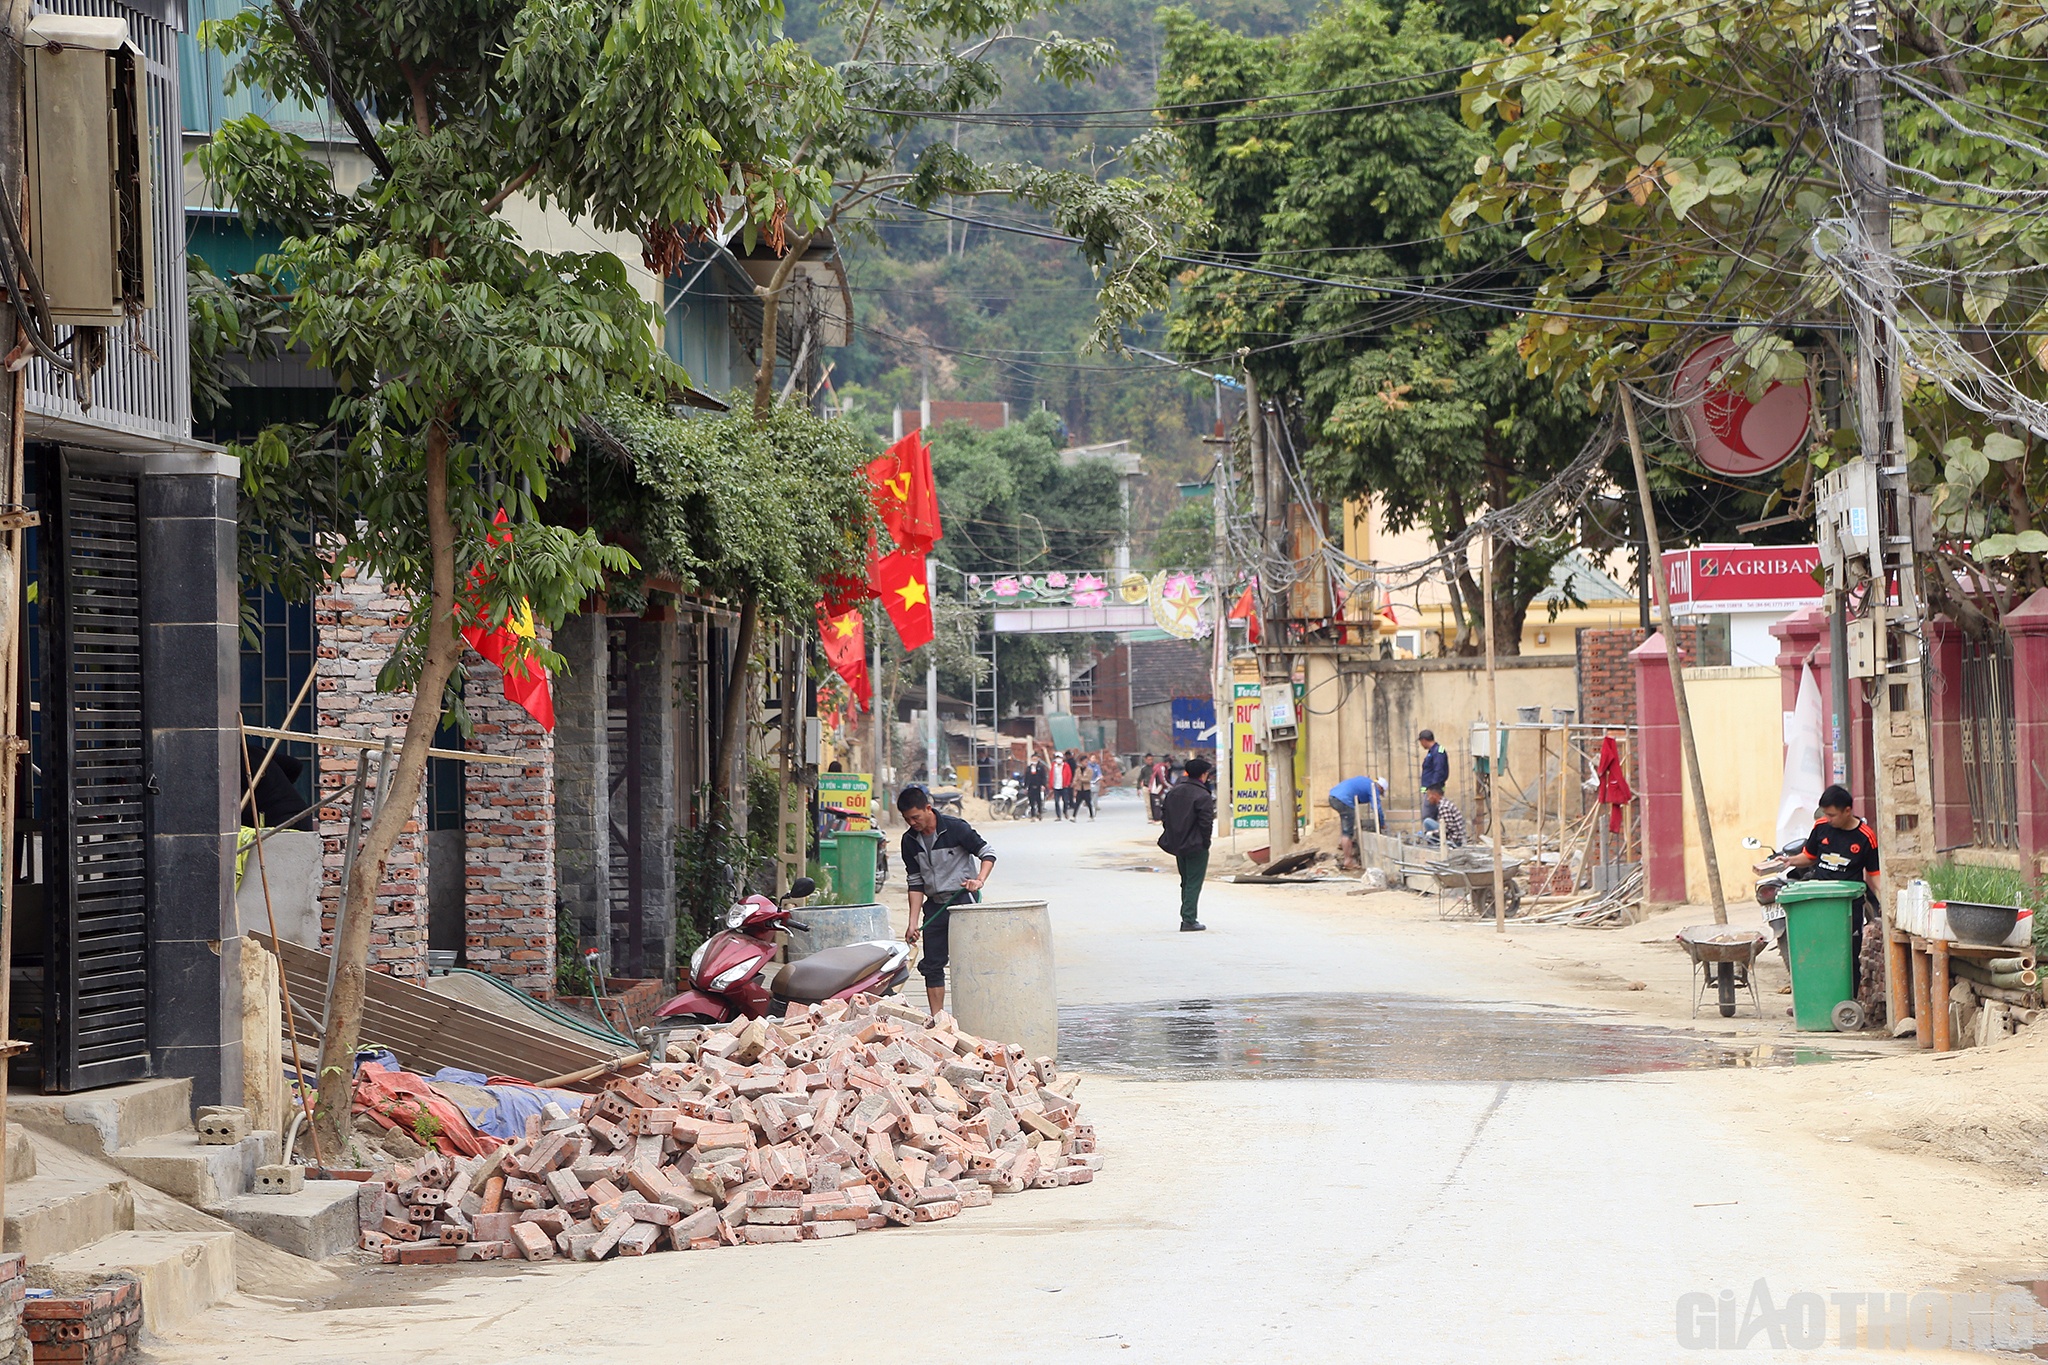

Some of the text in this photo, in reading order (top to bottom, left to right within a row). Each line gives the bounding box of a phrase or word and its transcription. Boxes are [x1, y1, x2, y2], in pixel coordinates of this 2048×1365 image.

[1722, 559, 1818, 575] AGRIBAN
[1669, 559, 1689, 595] ATM
[846, 793, 866, 807] GỐI
[1237, 803, 1253, 813] CHO
